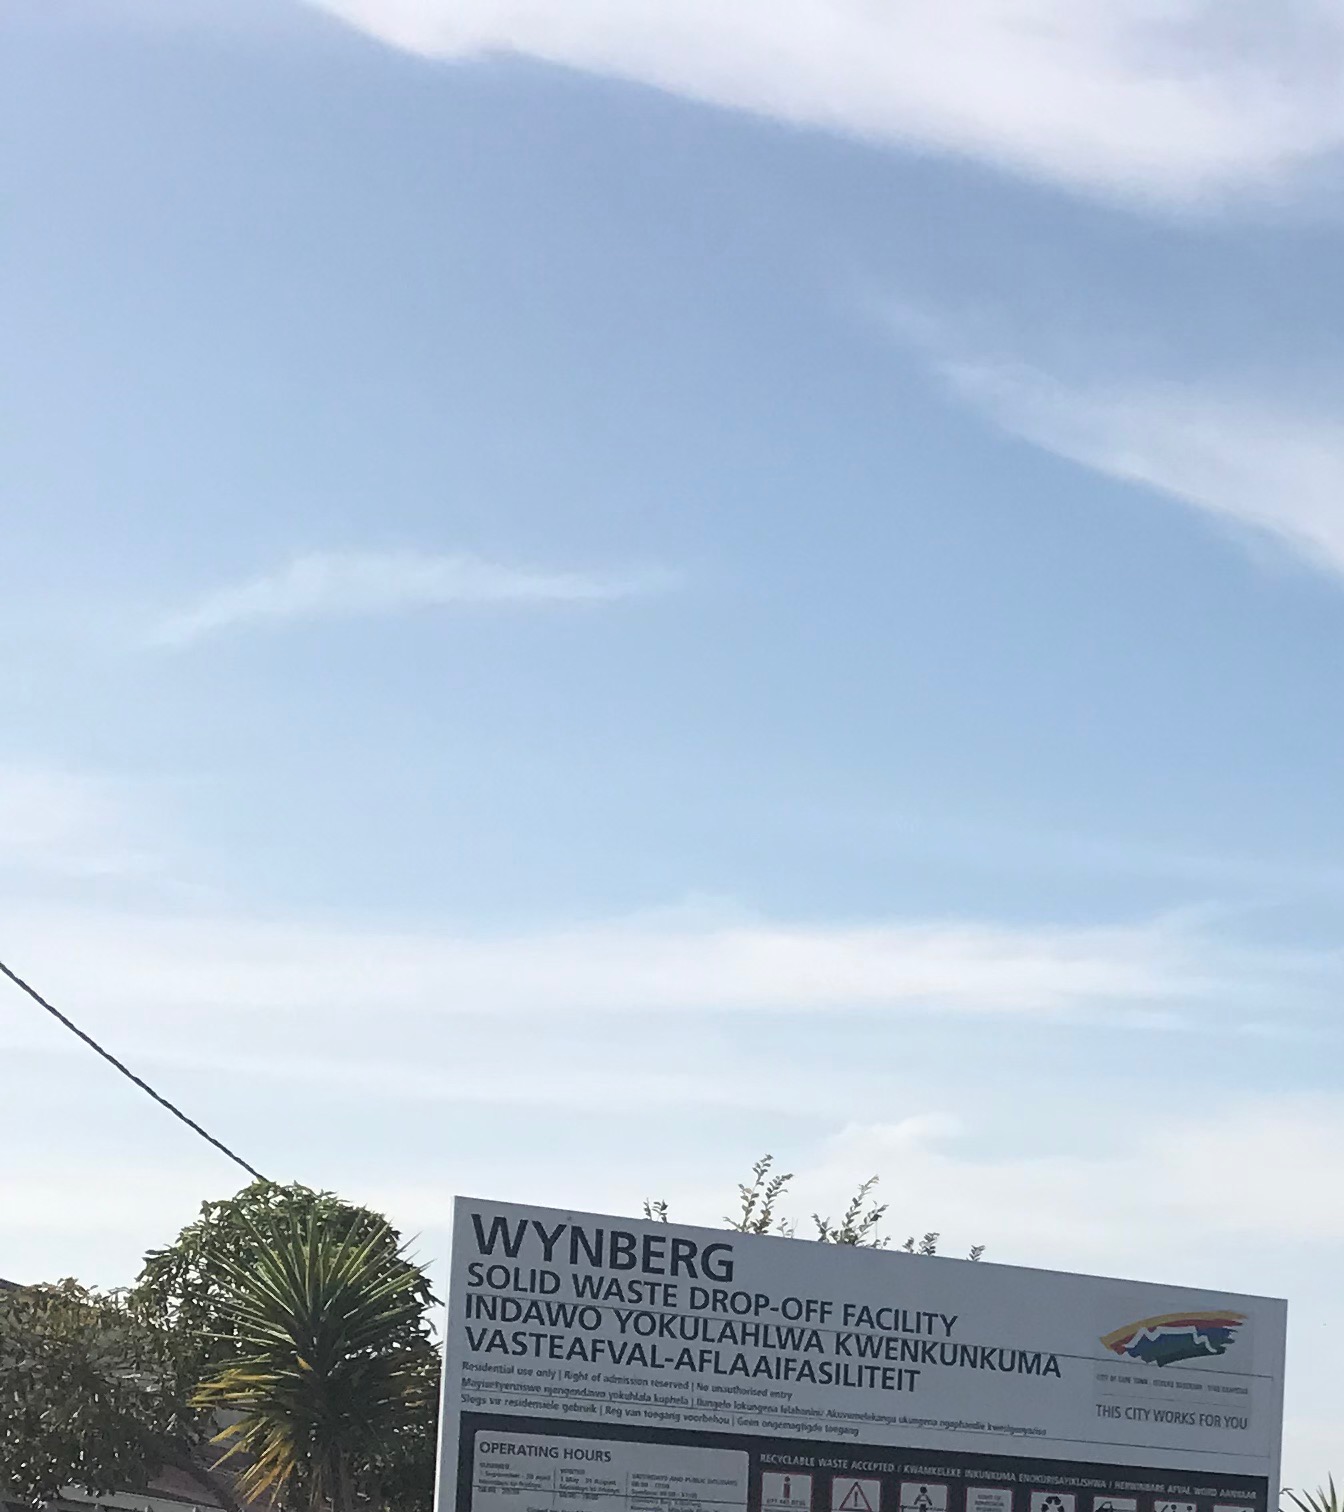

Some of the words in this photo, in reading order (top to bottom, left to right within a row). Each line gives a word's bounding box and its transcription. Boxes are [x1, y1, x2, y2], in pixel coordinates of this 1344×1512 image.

[471, 1214, 734, 1282] WYNBERG
[467, 1262, 560, 1295] SOLID
[572, 1273, 678, 1308] WASTE
[690, 1286, 833, 1324] DROP-OFF
[843, 1303, 958, 1337] FACILITY
[464, 1326, 921, 1392] VASTEAFVAL-AFLAAIFASILITEIT
[465, 1294, 602, 1331] INDAWO
[612, 1308, 824, 1354] YOKULAHLWA
[835, 1332, 1062, 1379] KWENKUNKUMA
[462, 1361, 514, 1375] Residential
[517, 1367, 533, 1376] use
[536, 1368, 556, 1381] only
[564, 1370, 589, 1383] Right
[591, 1372, 602, 1382] of
[603, 1374, 648, 1387] admission
[651, 1379, 689, 1390] reserved
[696, 1382, 709, 1392] No
[711, 1384, 768, 1398] unauthorised
[770, 1391, 793, 1401] entry
[1096, 1404, 1121, 1419] THIS
[1125, 1406, 1150, 1421] CITY
[1153, 1410, 1196, 1426] WORKS
[1199, 1413, 1221, 1428] FOR
[1224, 1416, 1249, 1430] YOU
[479, 1441, 559, 1459] OPERATING
[563, 1449, 612, 1463] HOURS
[760, 1453, 816, 1468] RECYCLABLE
[818, 1458, 848, 1470] WASTE
[851, 1461, 896, 1473] ACCEPTED
